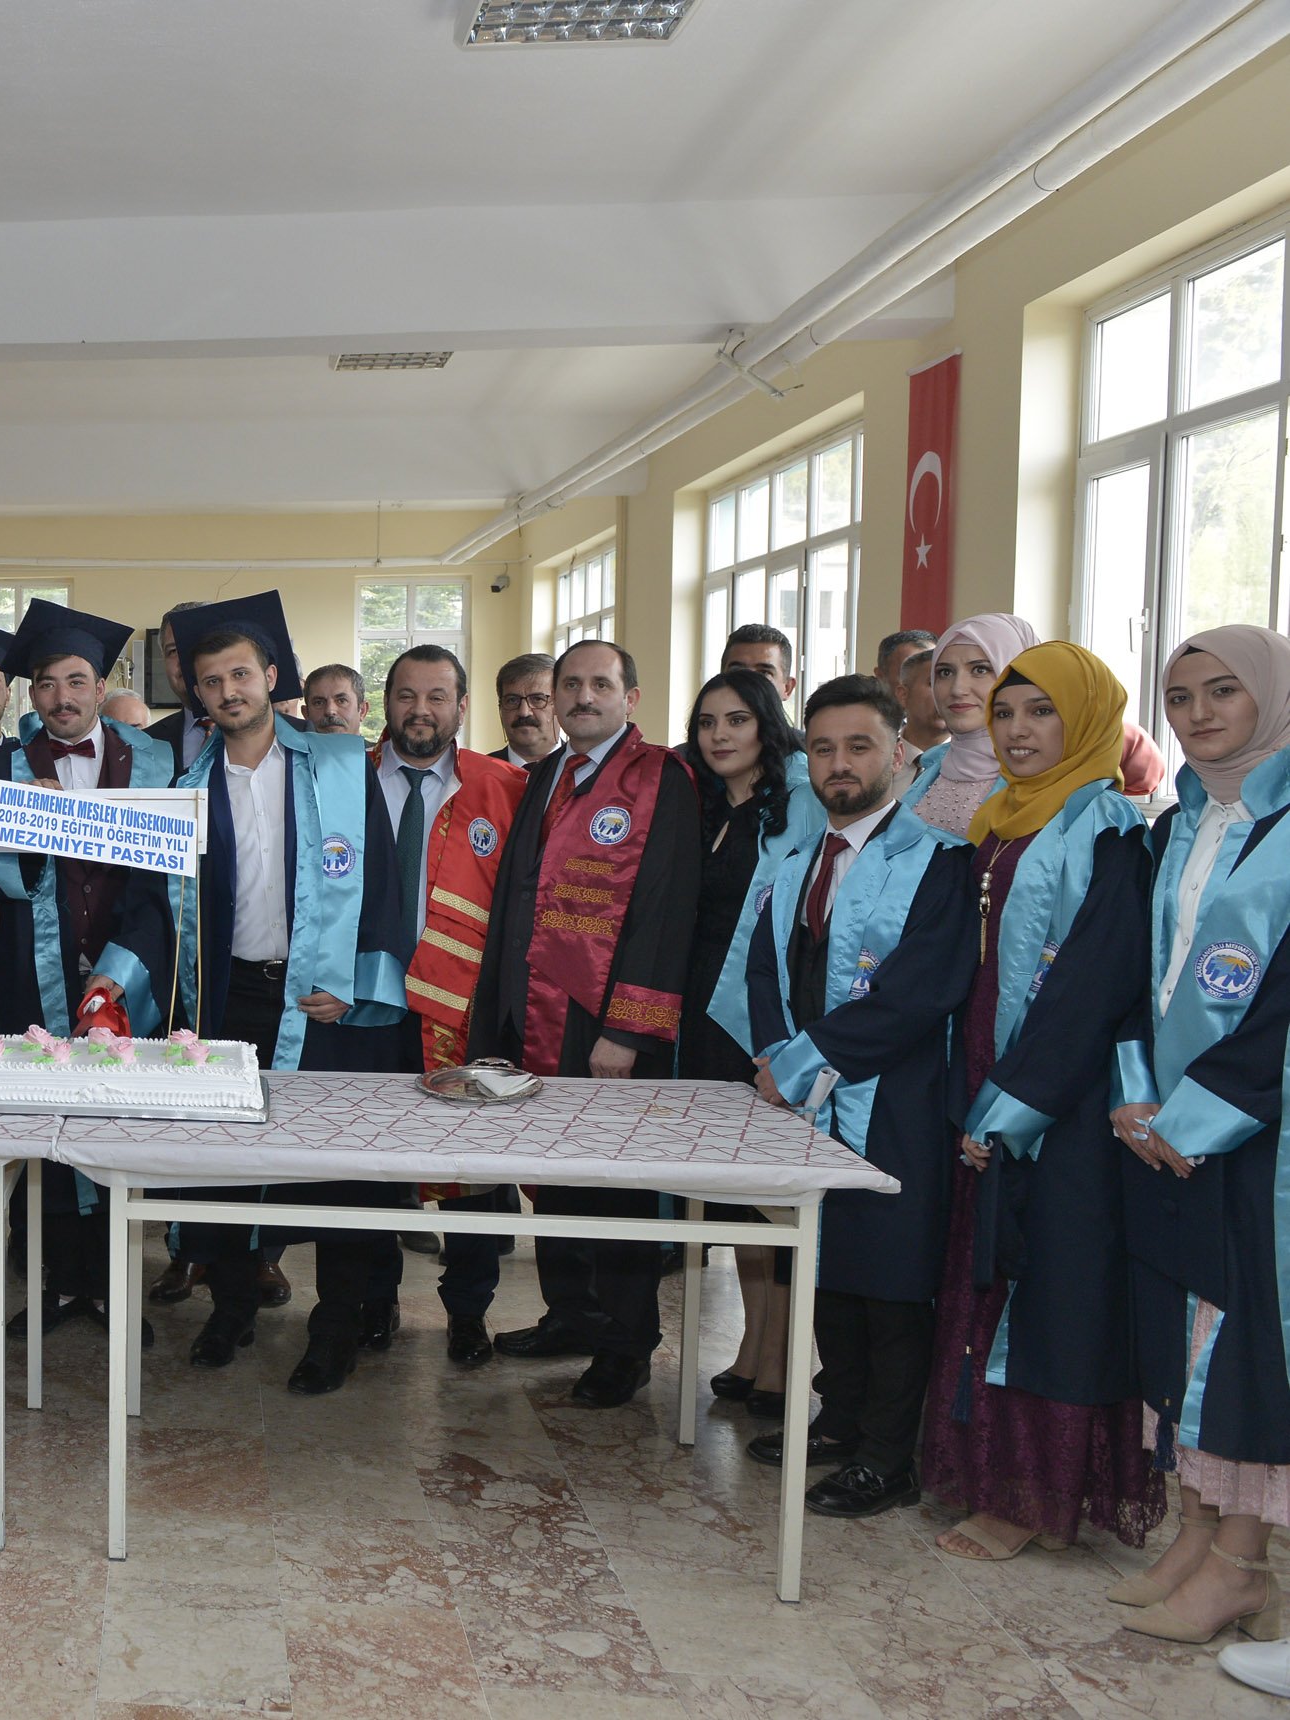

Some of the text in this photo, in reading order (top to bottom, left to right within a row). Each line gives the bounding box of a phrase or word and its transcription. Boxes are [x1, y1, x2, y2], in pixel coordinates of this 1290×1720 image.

[0, 786, 194, 837] KMU.ERMENEK MESLEK YÜKSEKOKULU
[0, 827, 184, 870] MEZUNİYET PASTASI
[61, 818, 103, 839] EĞİTİM
[107, 825, 162, 848] ÖĞRETİM
[165, 837, 188, 853] YILI
